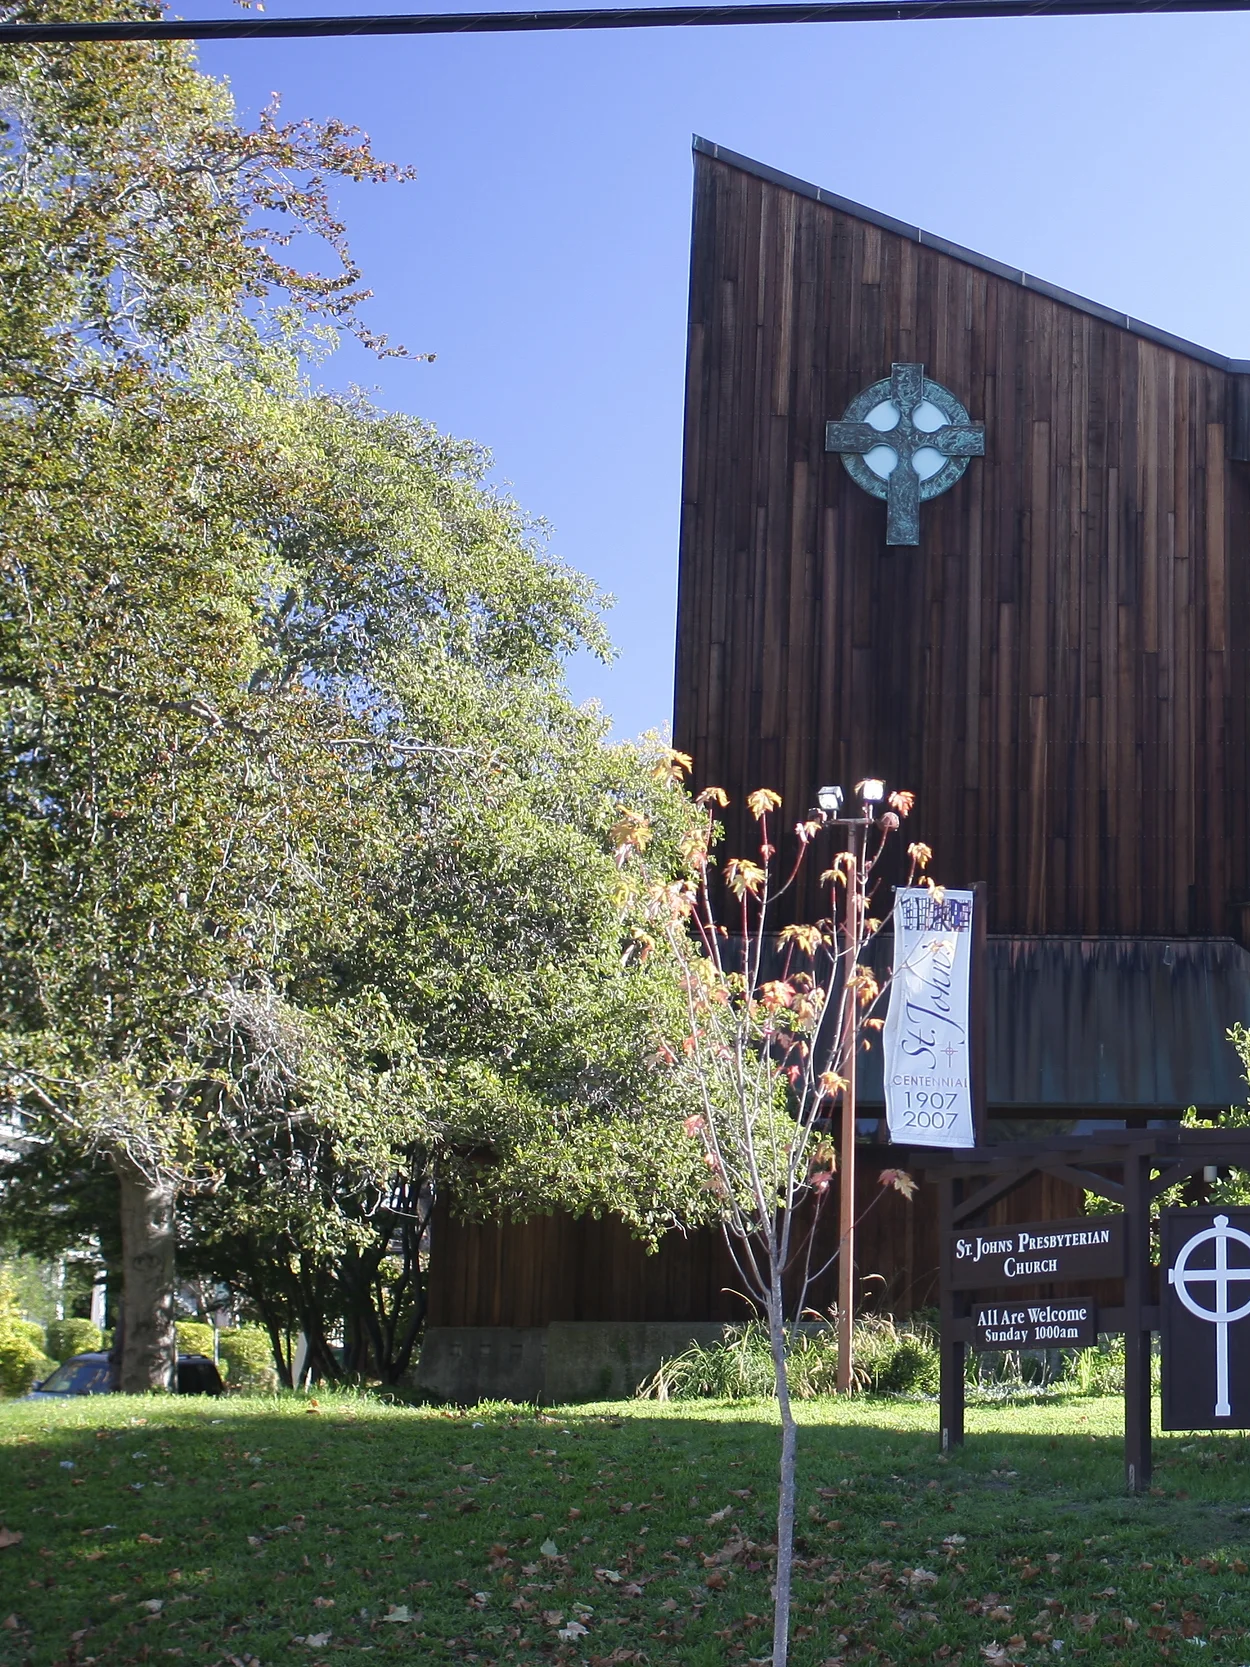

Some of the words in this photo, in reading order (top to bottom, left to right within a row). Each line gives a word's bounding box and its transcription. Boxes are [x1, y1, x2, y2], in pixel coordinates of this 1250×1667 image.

[901, 1028, 936, 1069] St.
[892, 1075, 968, 1088] CENTENNIAL
[905, 1091, 958, 1110] 1907
[903, 1110, 959, 1130] 2007
[1018, 1230, 1110, 1253] PRESBYTERIAN
[1003, 1257, 1058, 1278] CHURCH
[977, 1309, 998, 1327] All
[1001, 1309, 1025, 1326] Are
[1027, 1305, 1087, 1323] Welcome
[985, 1327, 1029, 1343] Sunday
